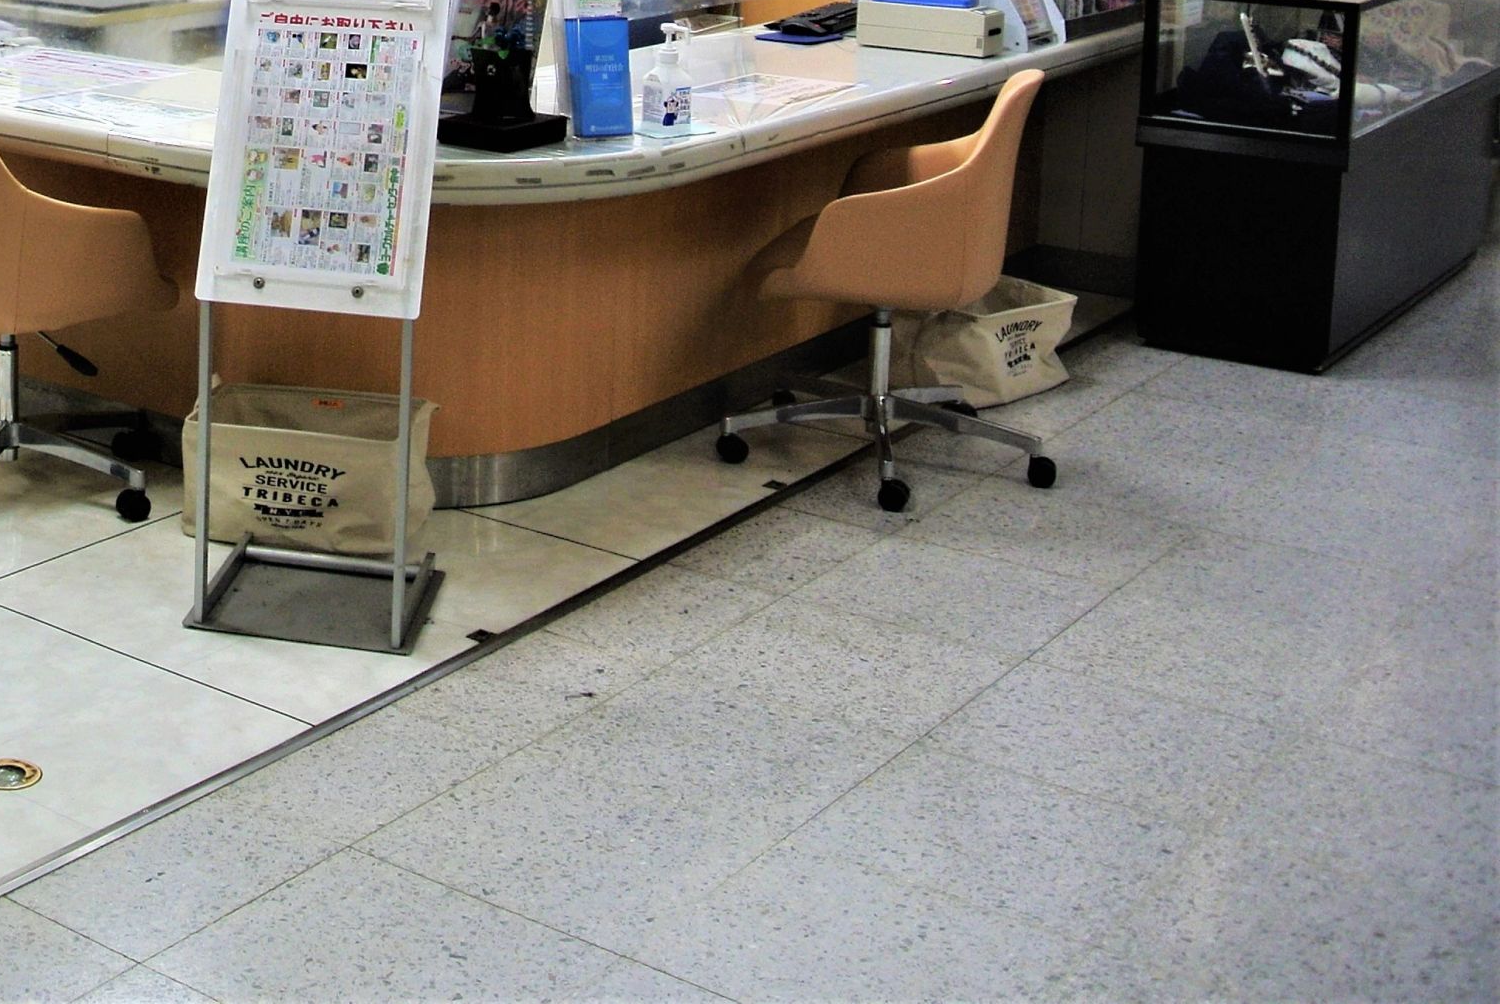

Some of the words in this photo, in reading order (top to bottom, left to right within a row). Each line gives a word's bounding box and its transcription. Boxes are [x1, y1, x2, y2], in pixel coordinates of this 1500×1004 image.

[995, 319, 1043, 343] LAUNDRY
[239, 456, 346, 481] LAUNDRY
[255, 474, 328, 495] SERVICE
[242, 486, 339, 508] TRIBECA
